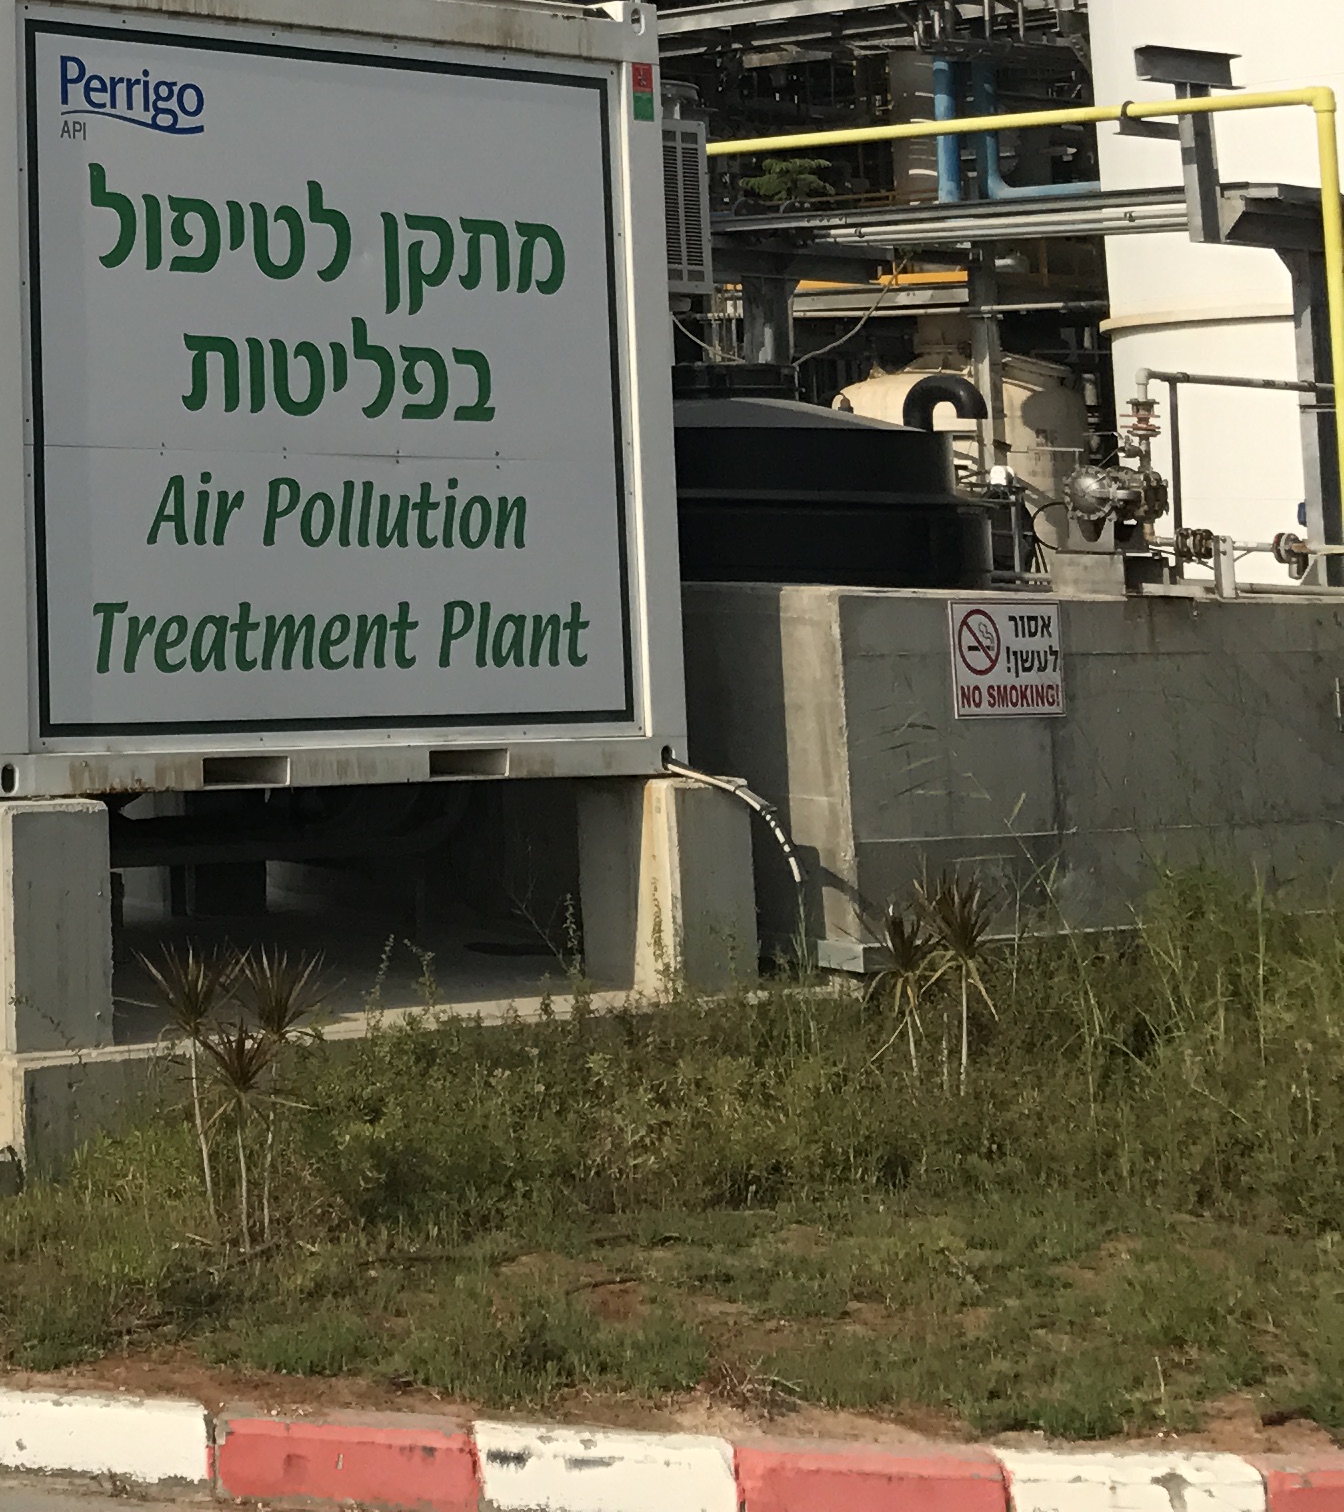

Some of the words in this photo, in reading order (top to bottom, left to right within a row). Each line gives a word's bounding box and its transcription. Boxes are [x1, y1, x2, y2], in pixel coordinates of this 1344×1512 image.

[60, 55, 204, 133] Perrigo
[60, 120, 87, 141] API
[88, 163, 352, 282] לטיפול
[380, 211, 566, 315] מתקן
[181, 316, 496, 422] בפליטות
[146, 471, 245, 546] Air
[263, 476, 527, 549] Pollution
[92, 600, 419, 674] Treatment
[438, 600, 591, 670] Plant
[1005, 644, 1060, 678] לעשן!
[1008, 614, 1052, 638] אסור
[960, 684, 983, 708] NO
[987, 684, 1060, 708] SMOKING!
